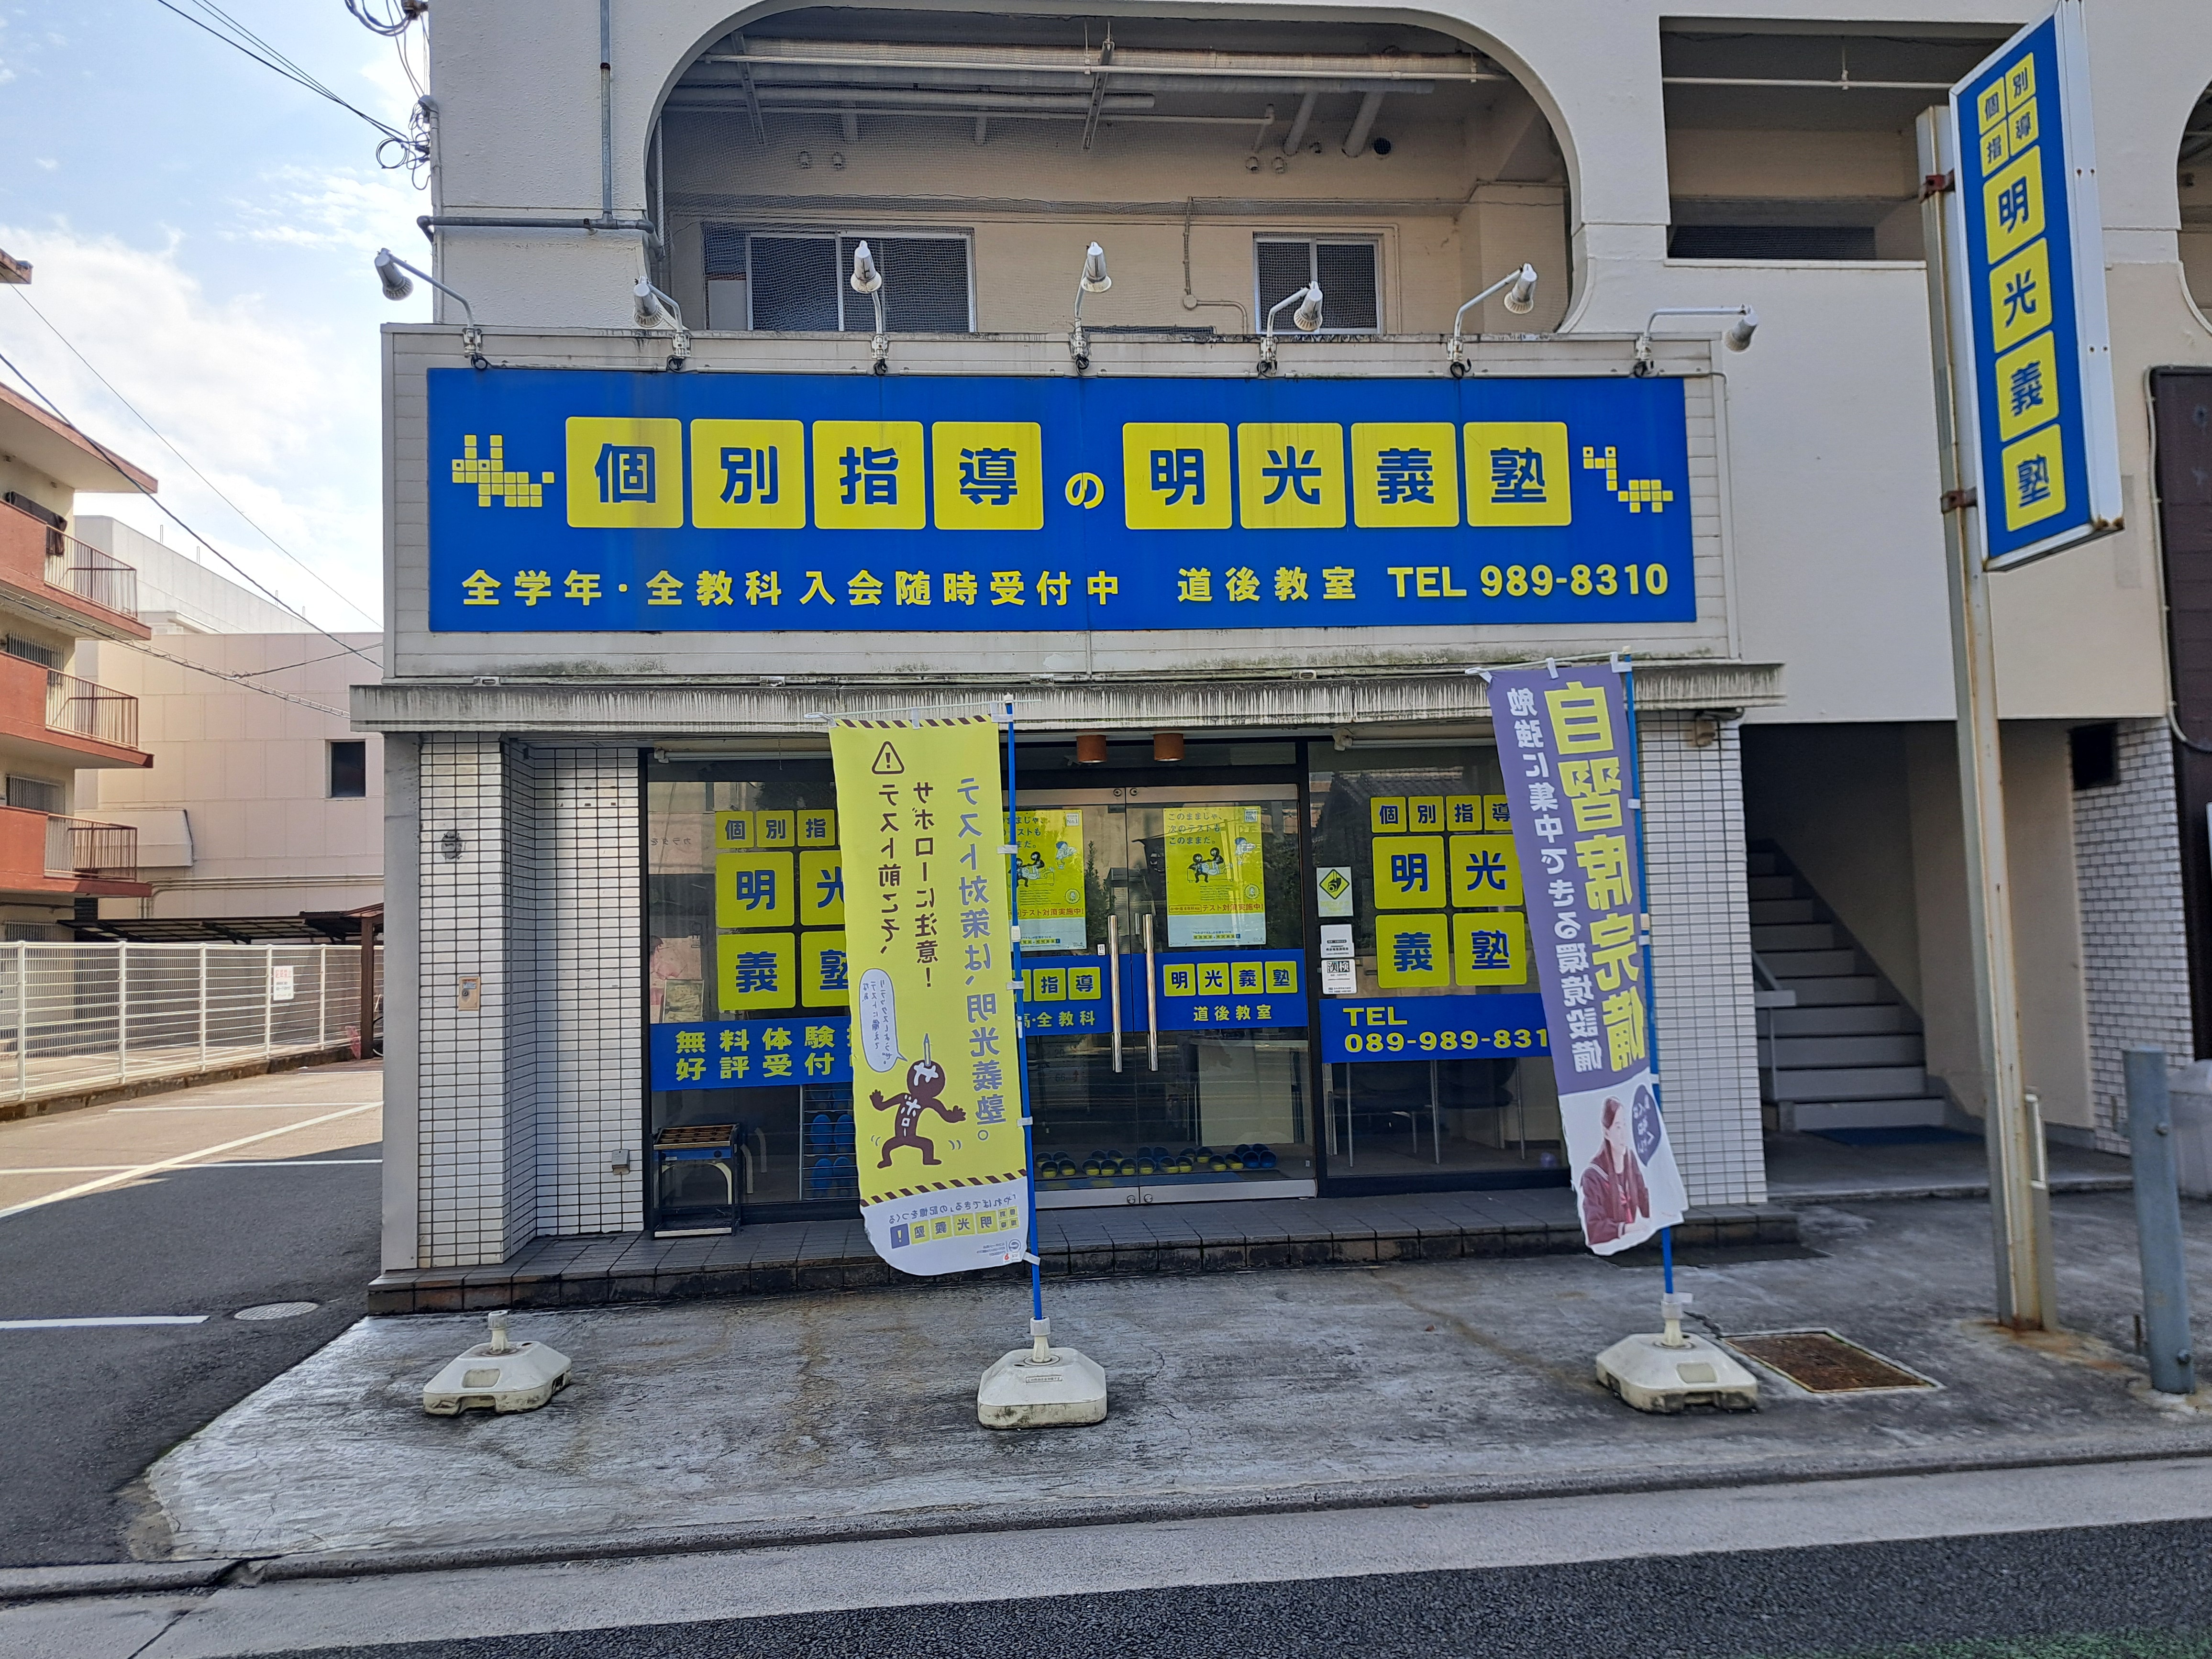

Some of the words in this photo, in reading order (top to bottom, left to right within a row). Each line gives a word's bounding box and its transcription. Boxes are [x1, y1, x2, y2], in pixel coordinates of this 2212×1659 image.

[1984, 66, 2029, 119] 個別
[1986, 113, 2032, 163] 指導
[1999, 188, 2051, 509] 明光義塾
[1177, 566, 1357, 603] 道後教室
[1387, 566, 1467, 598] TEL
[1480, 562, 1669, 597] 989-8310
[1380, 803, 1510, 825] 個別指導
[1392, 851, 1506, 893] 明光
[1393, 929, 1510, 972] 義塾
[1041, 974, 1094, 994] 指導
[1171, 968, 1290, 990] 明光義塾
[1193, 1005, 1272, 1022] 道後教室
[1343, 1006, 1407, 1027] TEL
[675, 1025, 852, 1054] 無料体験
[675, 1052, 852, 1081] 好評受付
